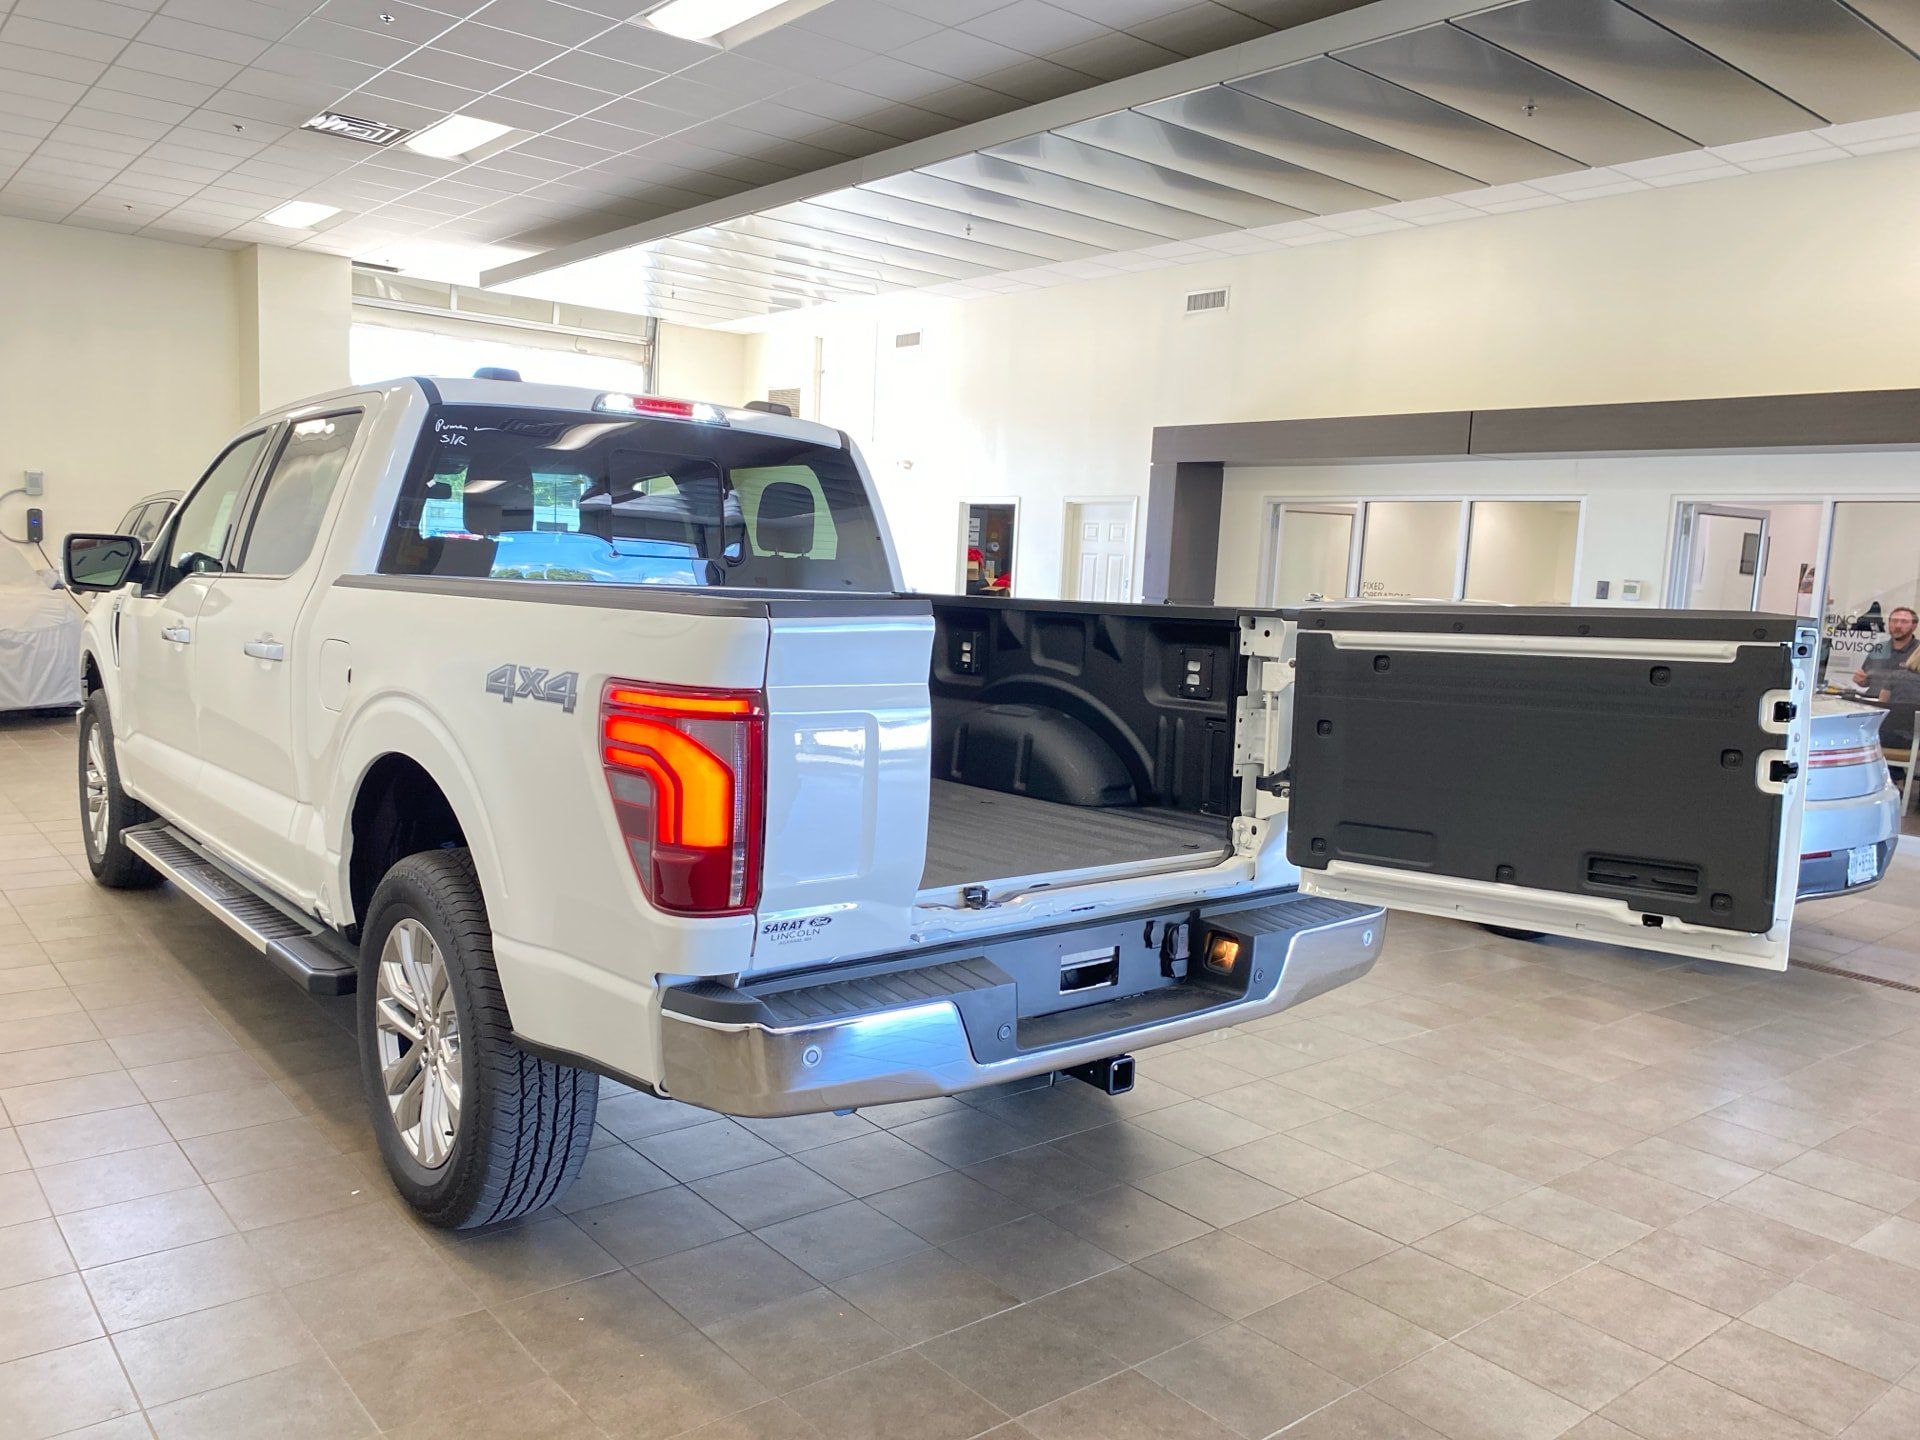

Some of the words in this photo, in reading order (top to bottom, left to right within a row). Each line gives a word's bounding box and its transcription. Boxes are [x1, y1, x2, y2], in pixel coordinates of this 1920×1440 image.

[1363, 581, 1385, 591] FIXED
[1826, 626, 1877, 640] SERVICE
[1826, 640, 1884, 653] ADVISOR
[763, 919, 805, 934] SARAT
[770, 928, 820, 942] LINCOLN
